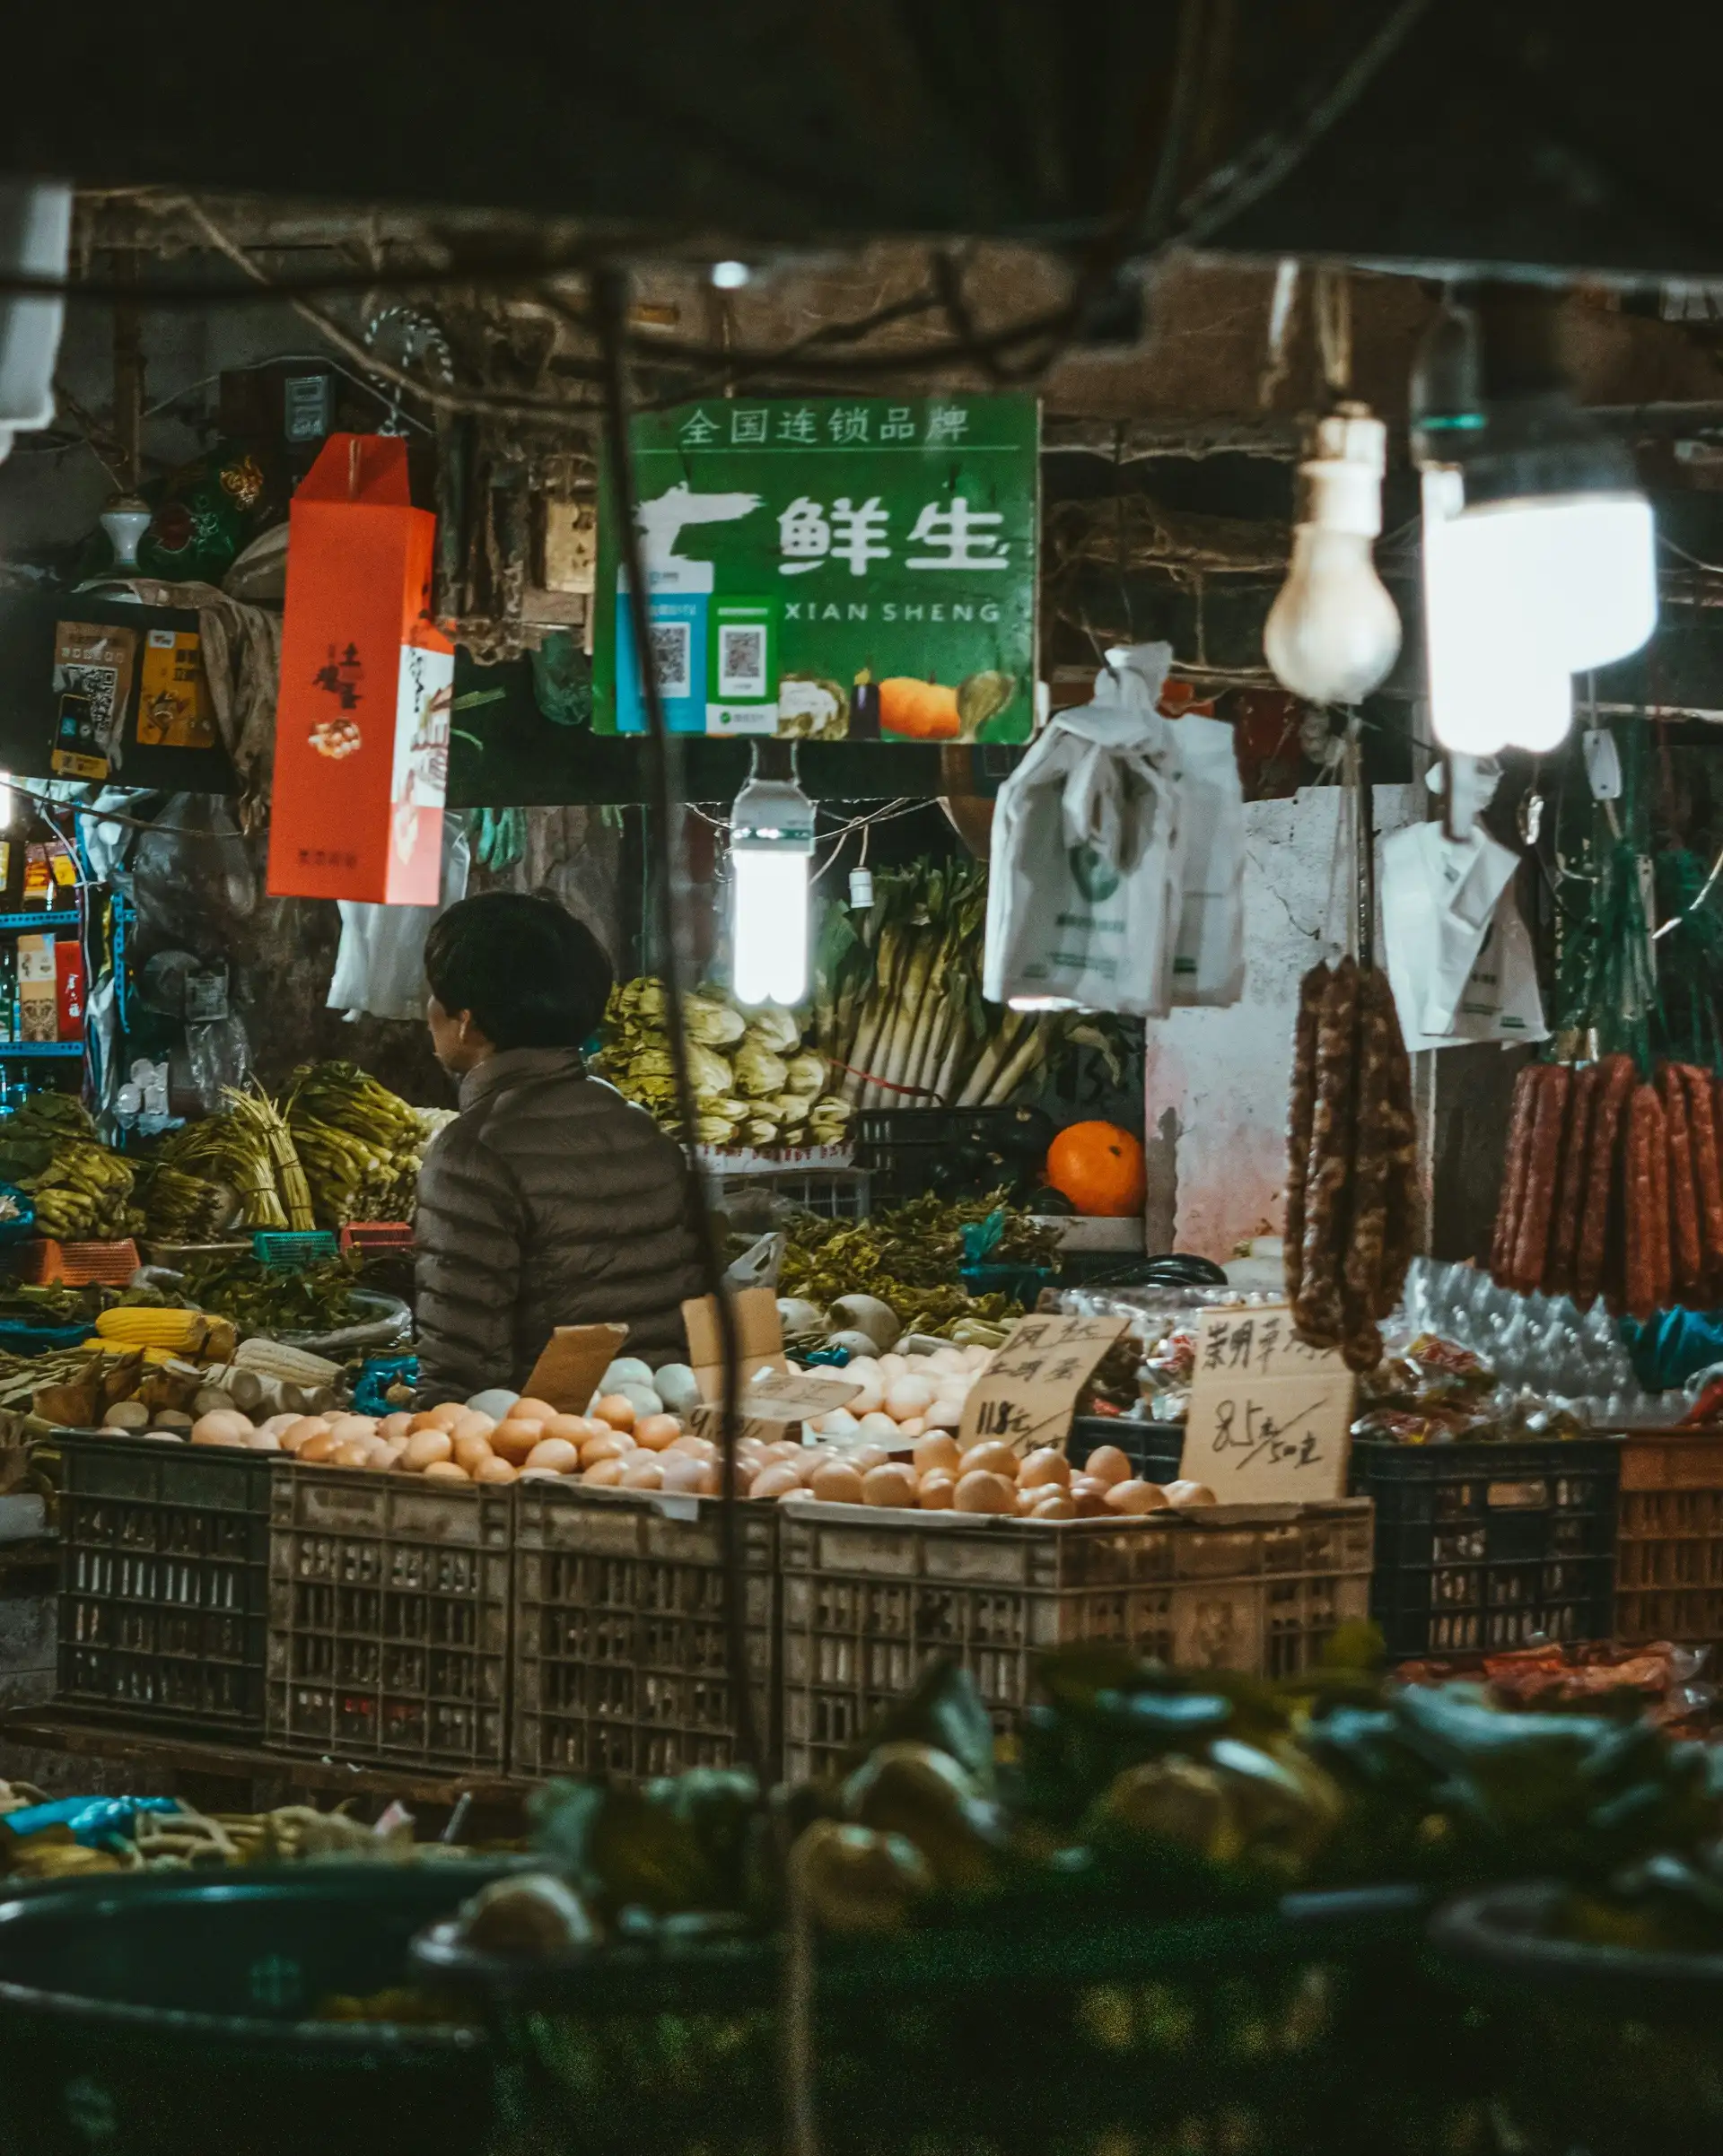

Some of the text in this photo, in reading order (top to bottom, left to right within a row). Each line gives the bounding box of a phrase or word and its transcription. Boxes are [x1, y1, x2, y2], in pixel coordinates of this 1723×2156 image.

[678, 406, 970, 444] 全国连锁品牌
[776, 496, 1010, 576] 鲜生
[784, 602, 869, 622] XIAN
[882, 602, 1001, 623] SHENG
